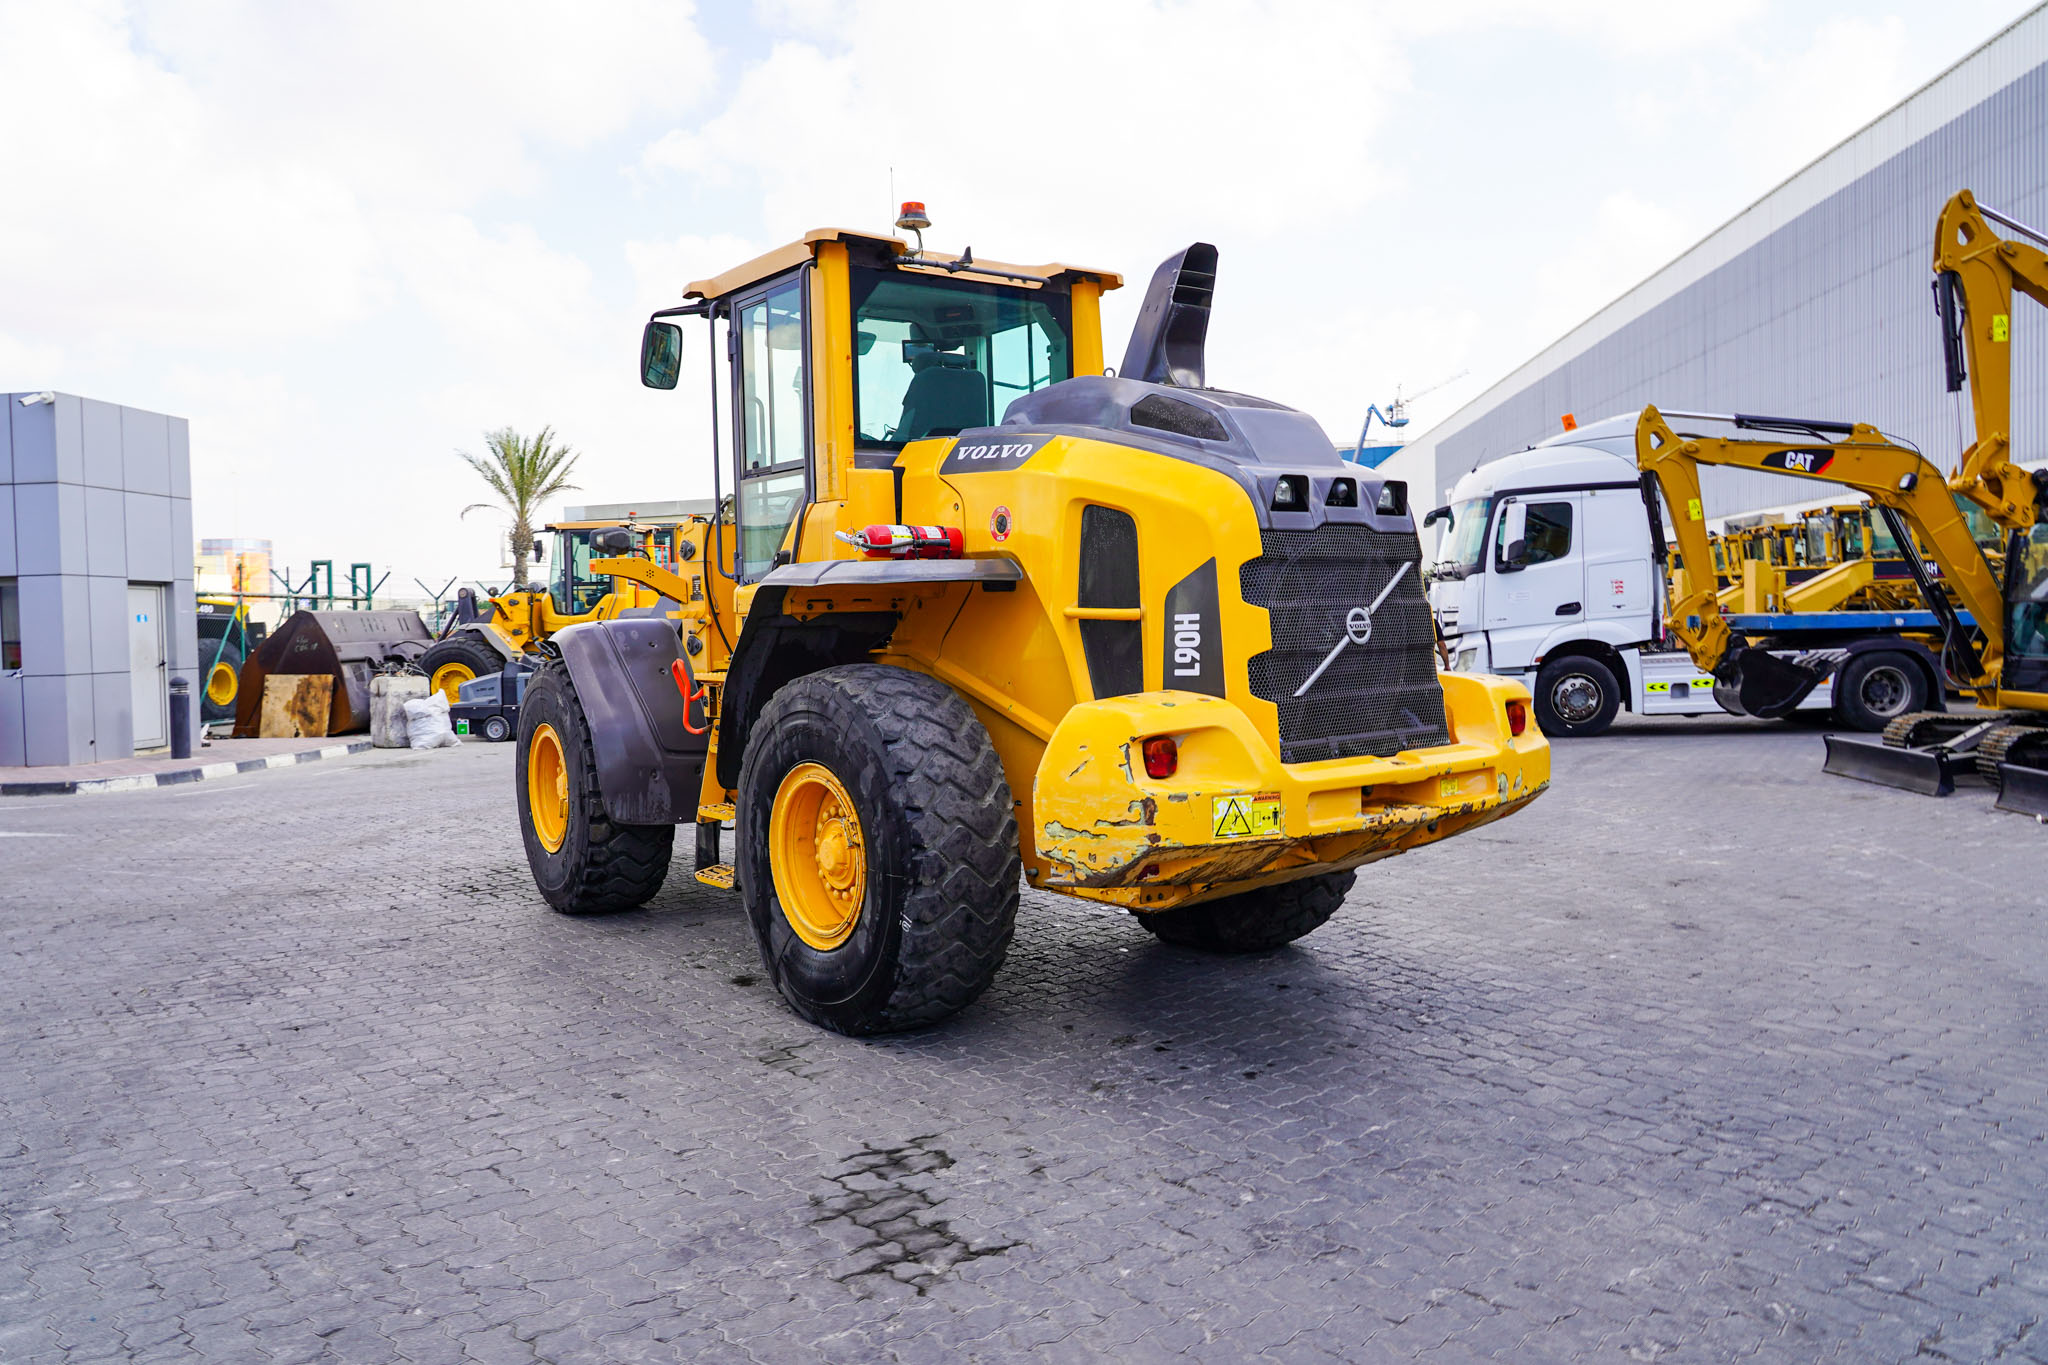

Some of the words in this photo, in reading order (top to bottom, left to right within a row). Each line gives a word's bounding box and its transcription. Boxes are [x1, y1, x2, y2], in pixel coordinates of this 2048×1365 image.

[957, 443, 1033, 460] VOLVO
[1785, 451, 1815, 472] CAT
[1174, 613, 1200, 676] L90H
